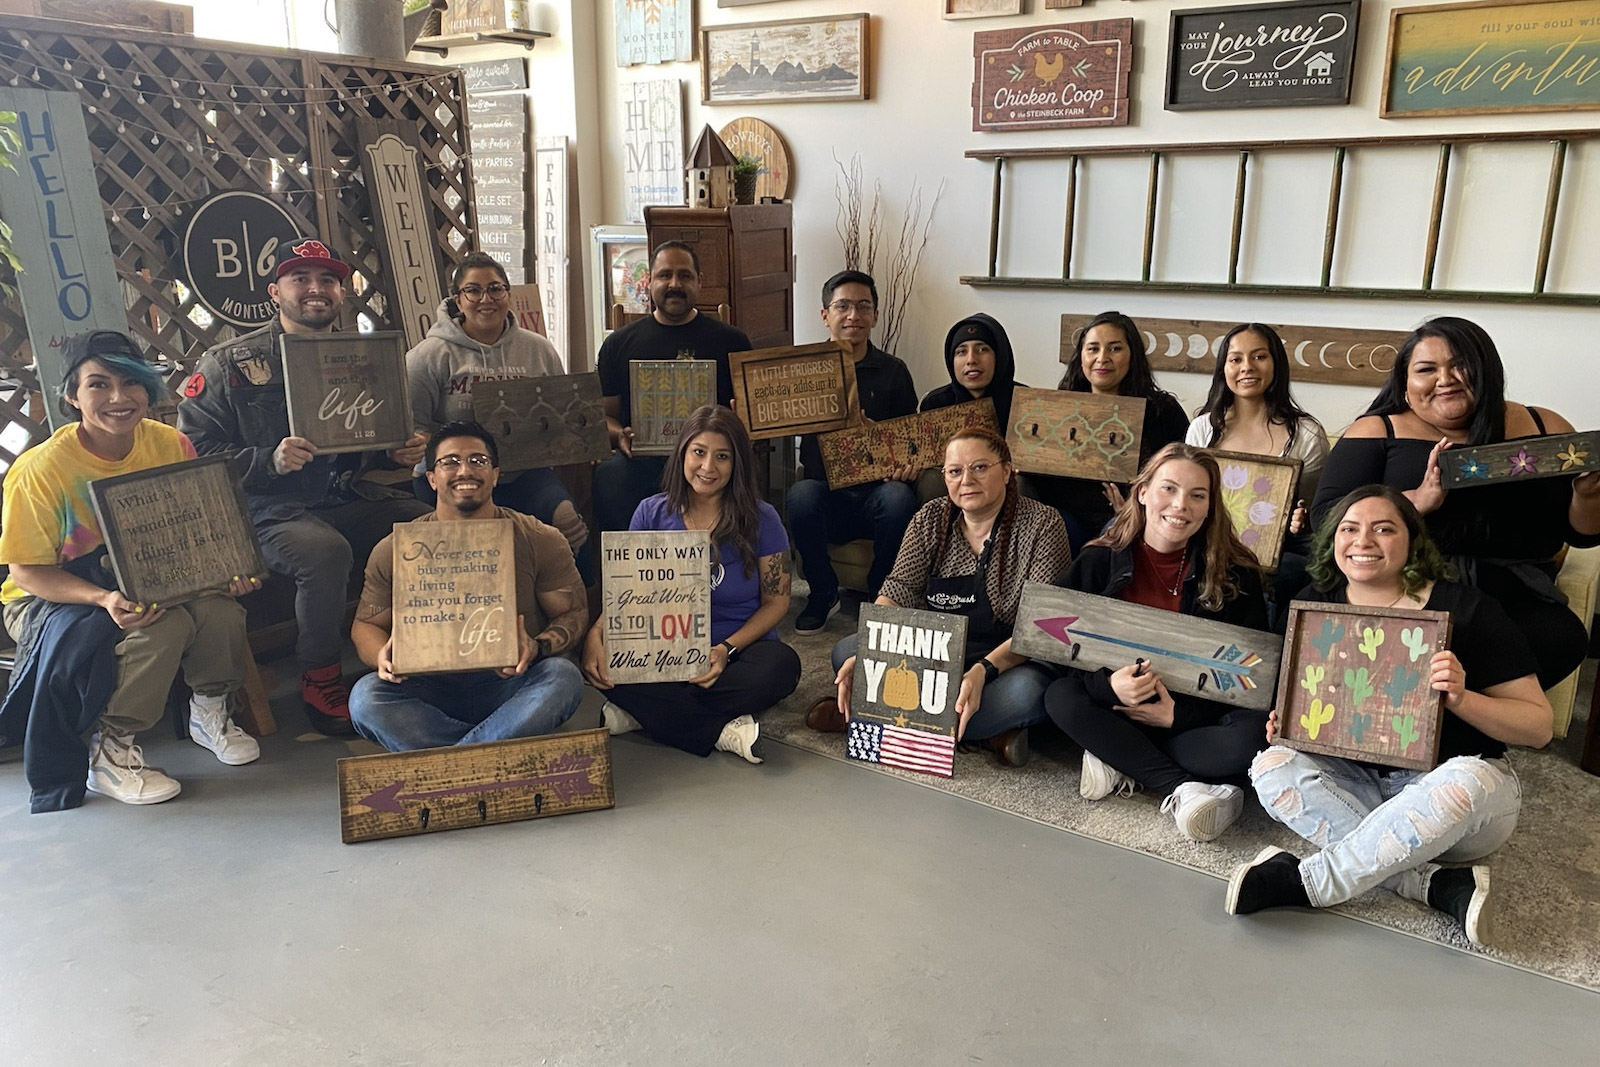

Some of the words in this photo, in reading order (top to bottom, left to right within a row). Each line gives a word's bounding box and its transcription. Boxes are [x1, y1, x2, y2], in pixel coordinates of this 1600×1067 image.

[1480, 24, 1500, 33] fill
[1505, 22, 1538, 34] your
[1543, 18, 1573, 29] soul
[1579, 16, 1600, 26] wit
[623, 31, 684, 43] MONTEREY
[1017, 38, 1041, 57] FARM
[1053, 36, 1080, 51] TABLE
[1180, 42, 1207, 50] YOUR
[1188, 32, 1210, 41] MAY
[1188, 12, 1348, 93] journey
[1404, 33, 1600, 96] adventu
[1241, 71, 1280, 80] ALWAYS
[1249, 80, 1274, 88] LEAD
[1278, 78, 1299, 87] YOU
[1302, 77, 1333, 86] HOME
[993, 83, 1058, 110] Chicken
[1061, 82, 1104, 109] Coop
[1026, 109, 1065, 119] STEINBECK
[1065, 107, 1085, 117] FARM
[725, 130, 772, 155] COWBOYS
[486, 157, 514, 168] PARTIES
[496, 195, 512, 206] SET
[543, 163, 557, 254] FARM
[19, 111, 92, 322] HELLO
[383, 163, 432, 339] WELCO
[221, 297, 281, 320] MONTERE
[469, 366, 495, 375] UNITD
[752, 369, 759, 382] A
[760, 365, 789, 381] LITTLE
[790, 359, 834, 377] PROGRESS
[754, 383, 774, 398] each
[776, 381, 791, 397] day
[828, 377, 837, 390] to
[318, 387, 385, 430] life
[757, 401, 780, 423] BIG
[783, 394, 839, 420] RESULTS
[117, 491, 161, 509] What
[127, 508, 203, 536] wonderful
[135, 544, 176, 563] thing
[178, 540, 190, 551] it
[193, 535, 206, 547] is
[210, 530, 225, 542] to
[403, 541, 460, 561] Never
[464, 550, 484, 561] get
[487, 548, 500, 557] so
[606, 549, 630, 561] THE
[636, 548, 668, 560] ONLY
[675, 547, 705, 559] WAY
[417, 565, 447, 577] busy
[450, 562, 498, 573] making
[638, 569, 654, 581] TO
[658, 568, 674, 580] DO
[143, 574, 162, 588] be
[408, 583, 415, 592] a
[419, 580, 455, 592] living
[438, 597, 461, 609] you
[464, 593, 503, 606] forget
[618, 589, 658, 610] Great
[659, 587, 696, 604] Work
[949, 593, 977, 605] Brush
[403, 615, 417, 624] to
[420, 611, 456, 623] make
[458, 612, 466, 621] a
[608, 616, 622, 630] IS
[627, 615, 645, 629] TO
[650, 614, 706, 640] LOVE
[458, 607, 504, 656] life.
[866, 620, 952, 662] THANK
[610, 650, 652, 669] What
[655, 648, 683, 672] You
[686, 648, 707, 665] Do
[863, 658, 949, 715] YU
